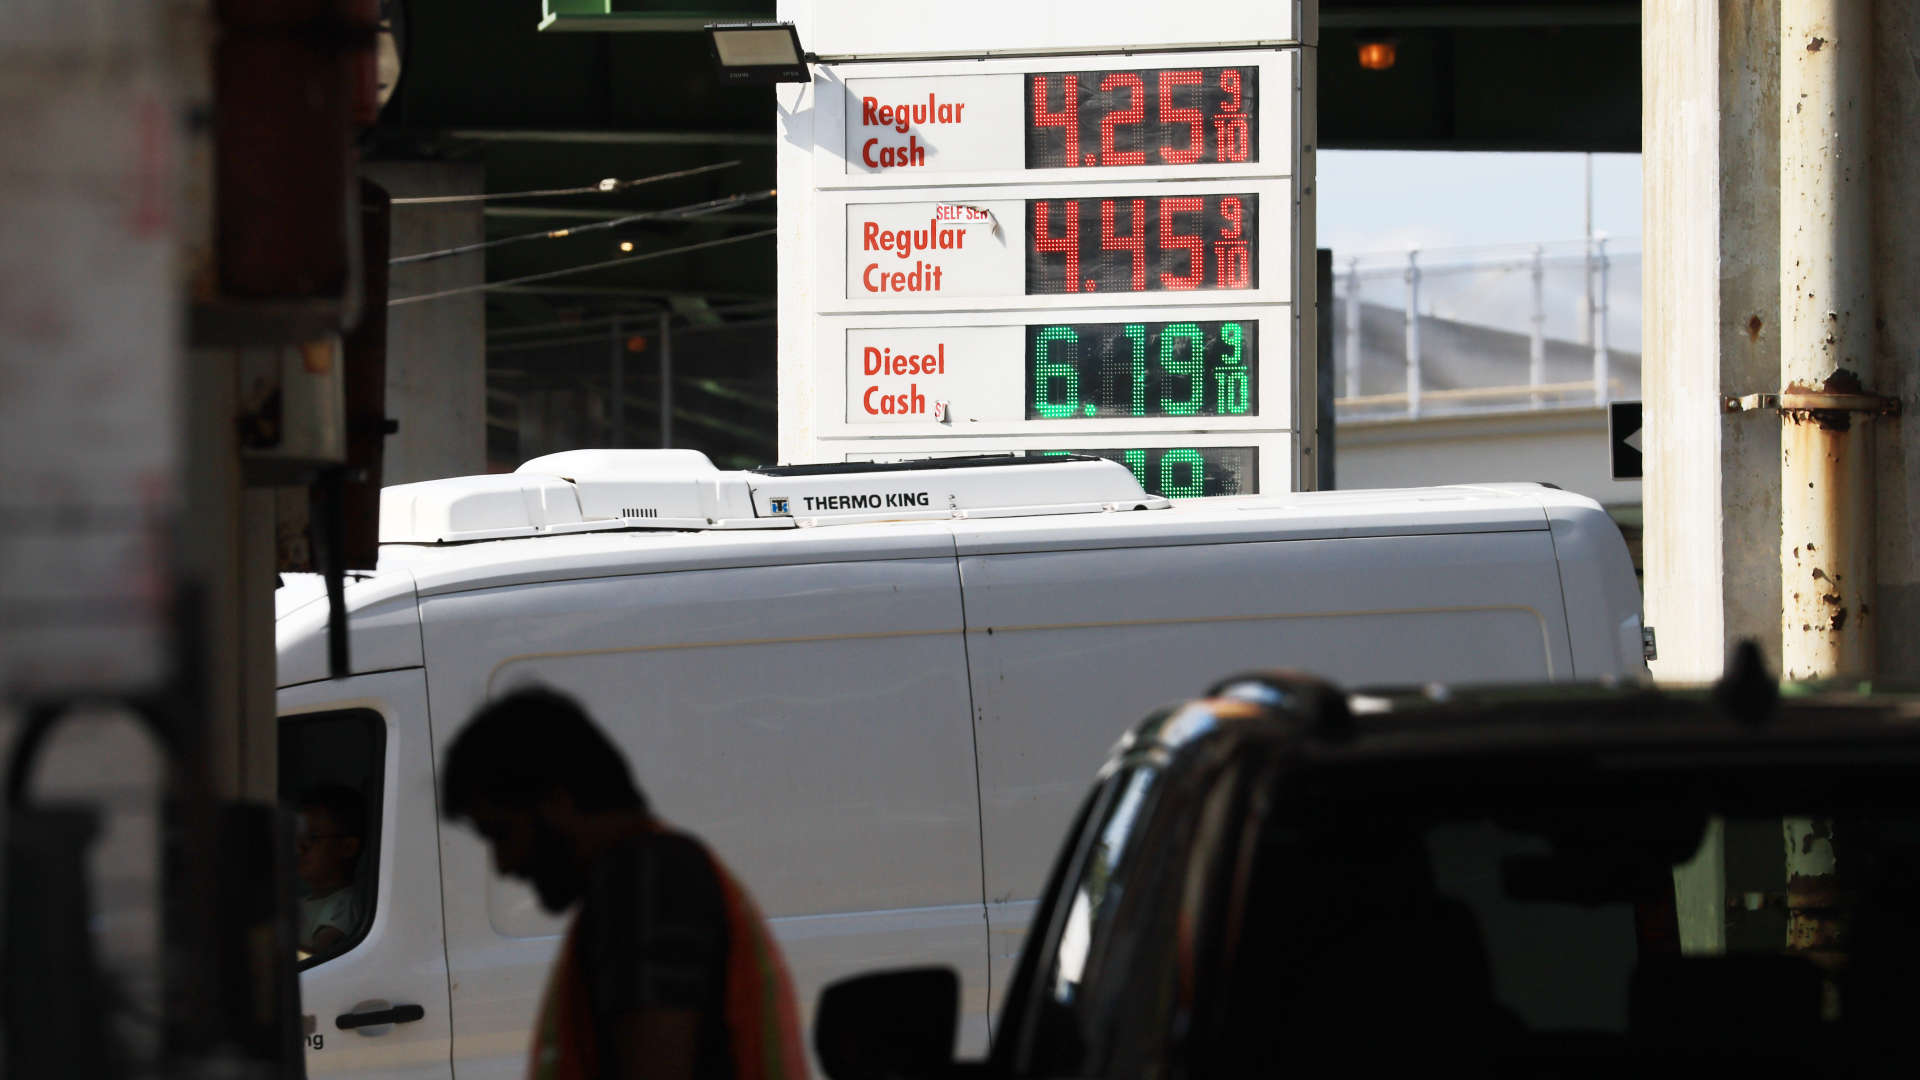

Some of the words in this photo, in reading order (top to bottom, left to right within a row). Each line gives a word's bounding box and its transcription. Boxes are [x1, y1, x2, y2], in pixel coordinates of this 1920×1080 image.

[863, 93, 965, 133] Regular
[1034, 70, 1205, 168] 4.25
[862, 136, 925, 168] Cash
[936, 205, 963, 220] SELF
[863, 219, 967, 263] Regular
[1034, 197, 1205, 293] 4.45
[863, 260, 943, 293] Credit
[863, 343, 945, 376] Diesel
[1035, 323, 1205, 418] 6.19
[863, 383, 926, 416] Cash
[803, 494, 882, 511] THERMO
[886, 492, 929, 508] KING
